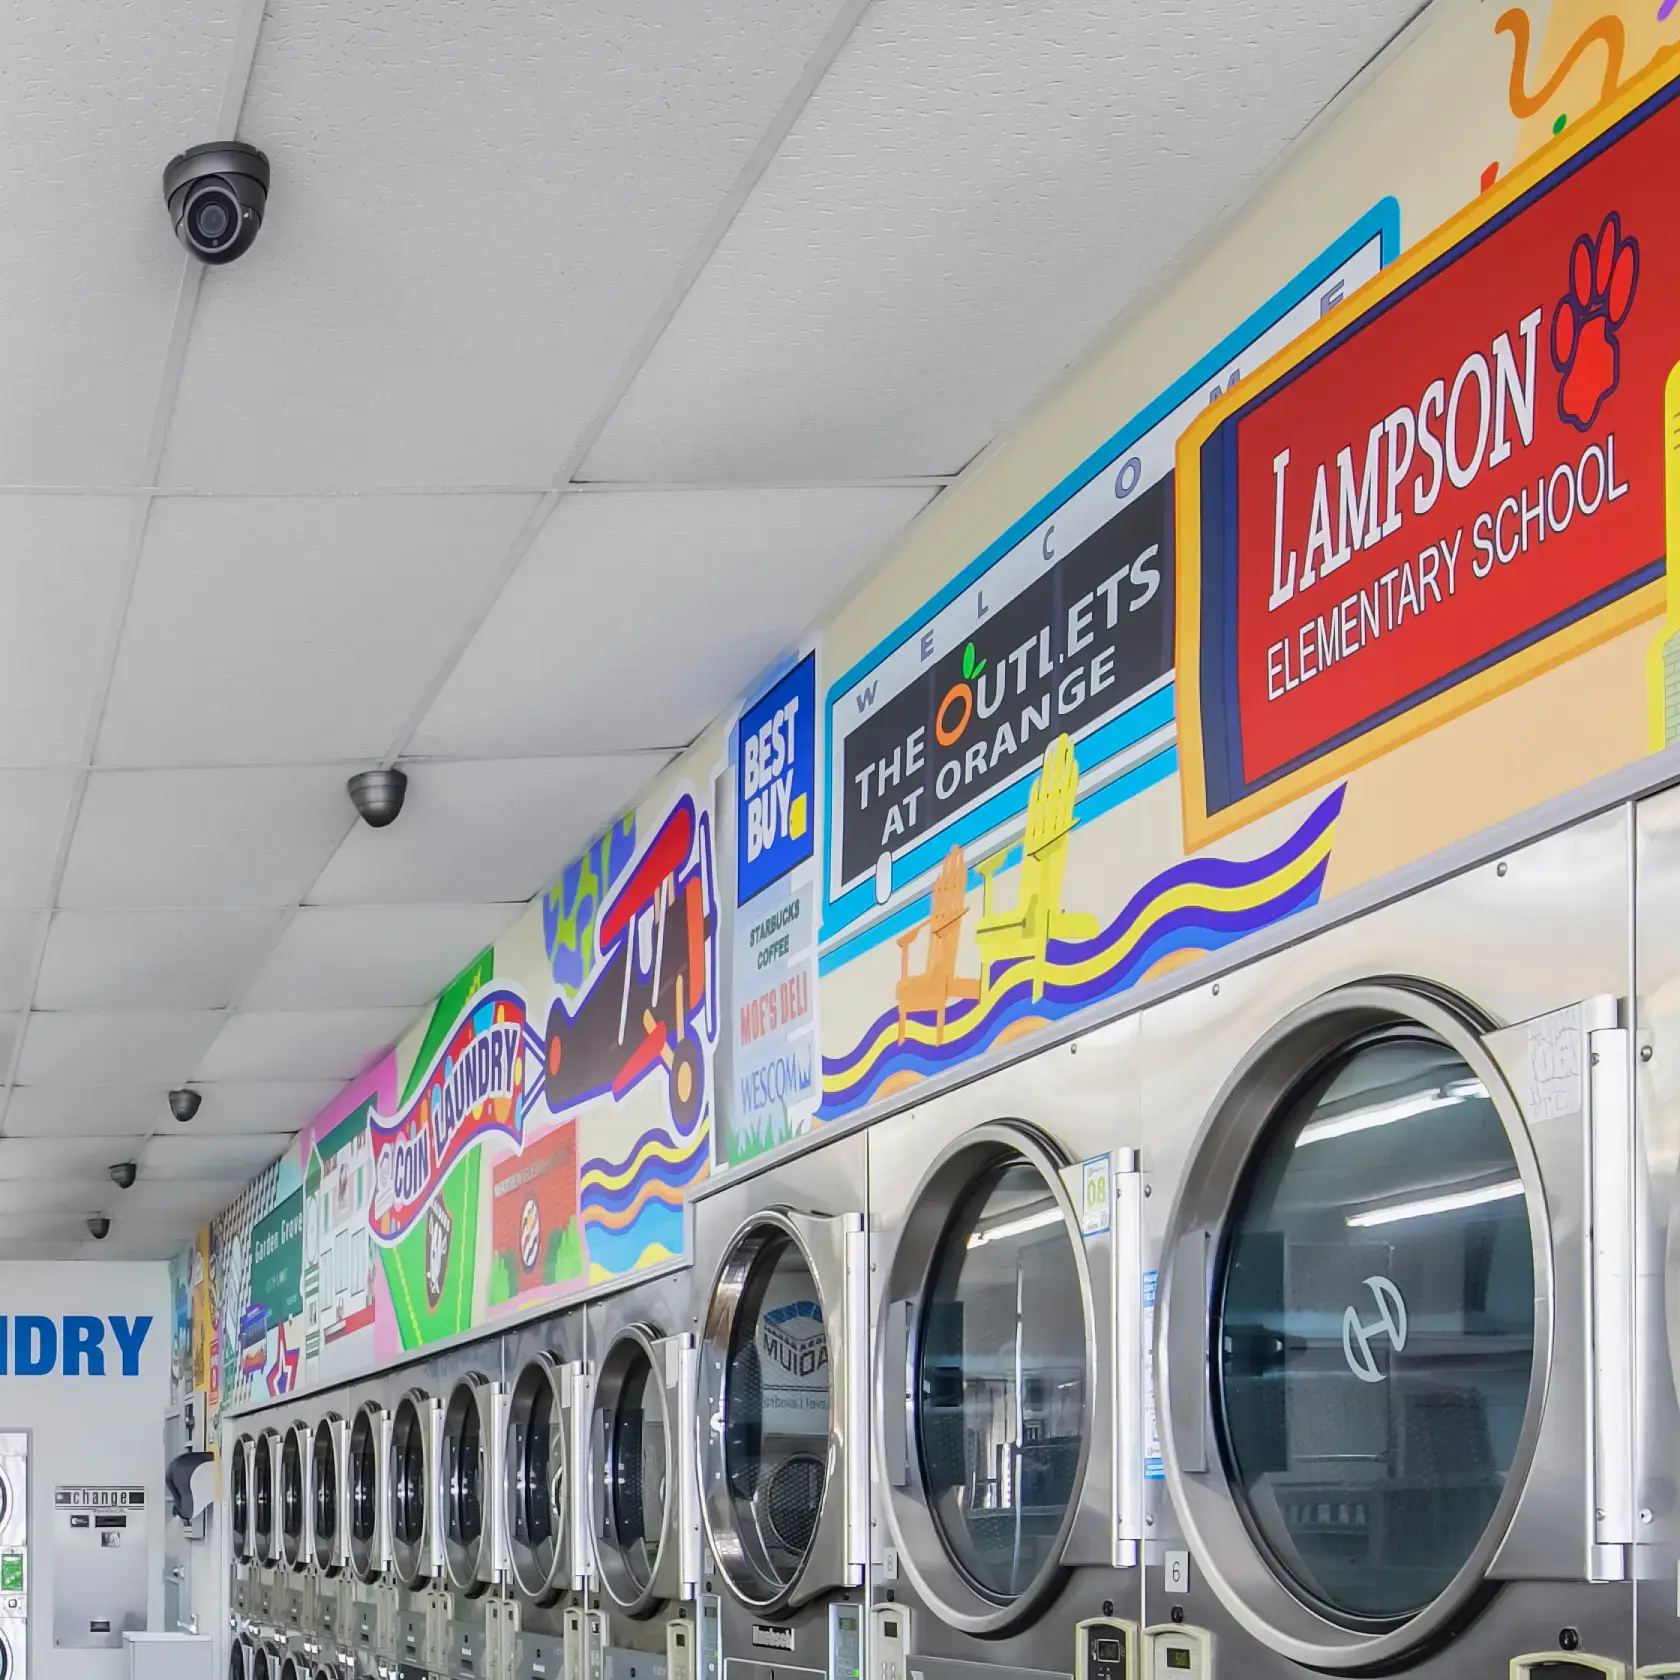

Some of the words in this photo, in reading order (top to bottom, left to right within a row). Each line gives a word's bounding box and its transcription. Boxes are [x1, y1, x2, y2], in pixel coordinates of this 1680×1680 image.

[1269, 307, 1543, 612] LAMPSON
[1267, 529, 1463, 702] ELEMENTARY
[1472, 433, 1630, 580] SCHOOL
[855, 726, 925, 810] THE
[935, 543, 1160, 747] OUTLETS
[744, 695, 799, 801] BEST
[881, 793, 923, 845] AT
[935, 645, 1116, 800] ORANGE
[747, 768, 794, 864] BUY
[750, 898, 800, 948] STARBUCKS
[757, 934, 790, 970] COFFEE
[741, 987, 777, 1046] MOE'S
[780, 970, 808, 1025] DELI
[394, 1128, 429, 1199] COIN
[434, 1027, 519, 1147] LAUNDRY
[741, 1051, 796, 1115] WESCOM
[255, 1231, 279, 1264] Garden
[281, 1212, 303, 1245] Grove
[73, 1488, 127, 1507] change
[1172, 1562, 1181, 1582] 6
